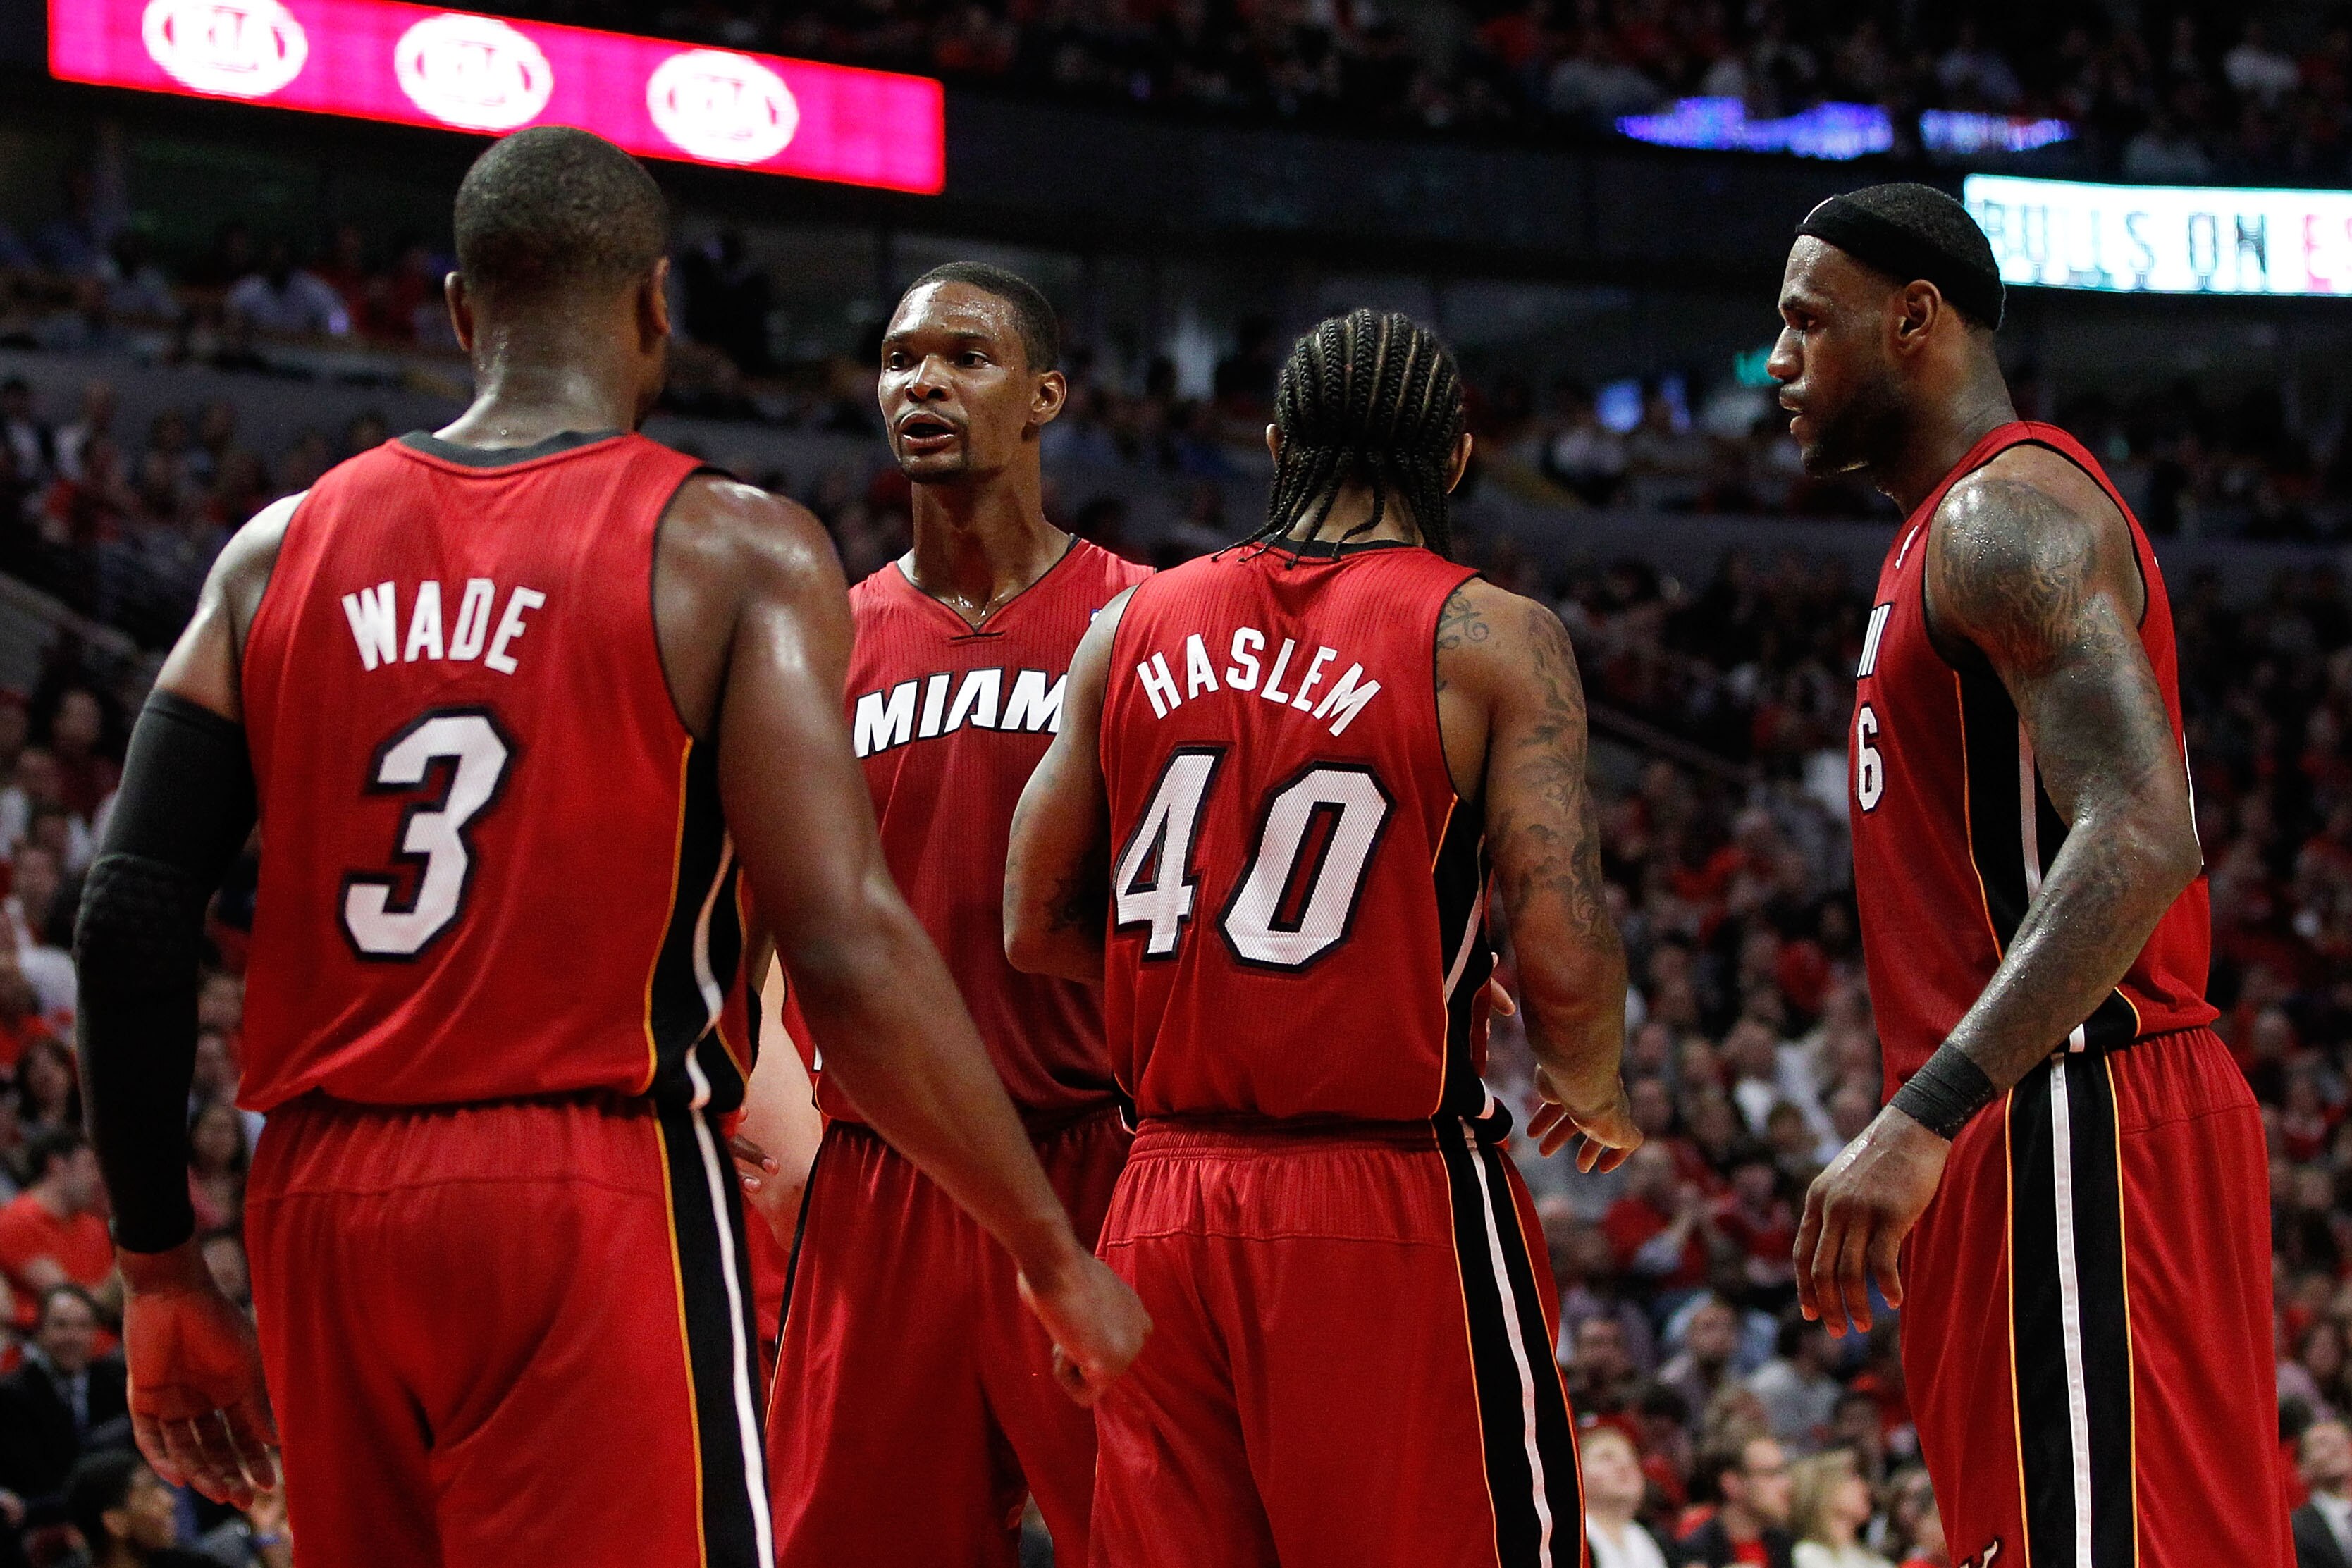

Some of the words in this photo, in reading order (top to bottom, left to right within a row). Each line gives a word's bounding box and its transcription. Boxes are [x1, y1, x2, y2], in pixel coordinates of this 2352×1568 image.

[2187, 211, 2267, 290] ON
[341, 578, 547, 675] WADE
[1136, 626, 1381, 737] HASLEM
[1856, 703, 1886, 813] 6
[339, 708, 519, 961] 3
[1112, 746, 1396, 973] 40
